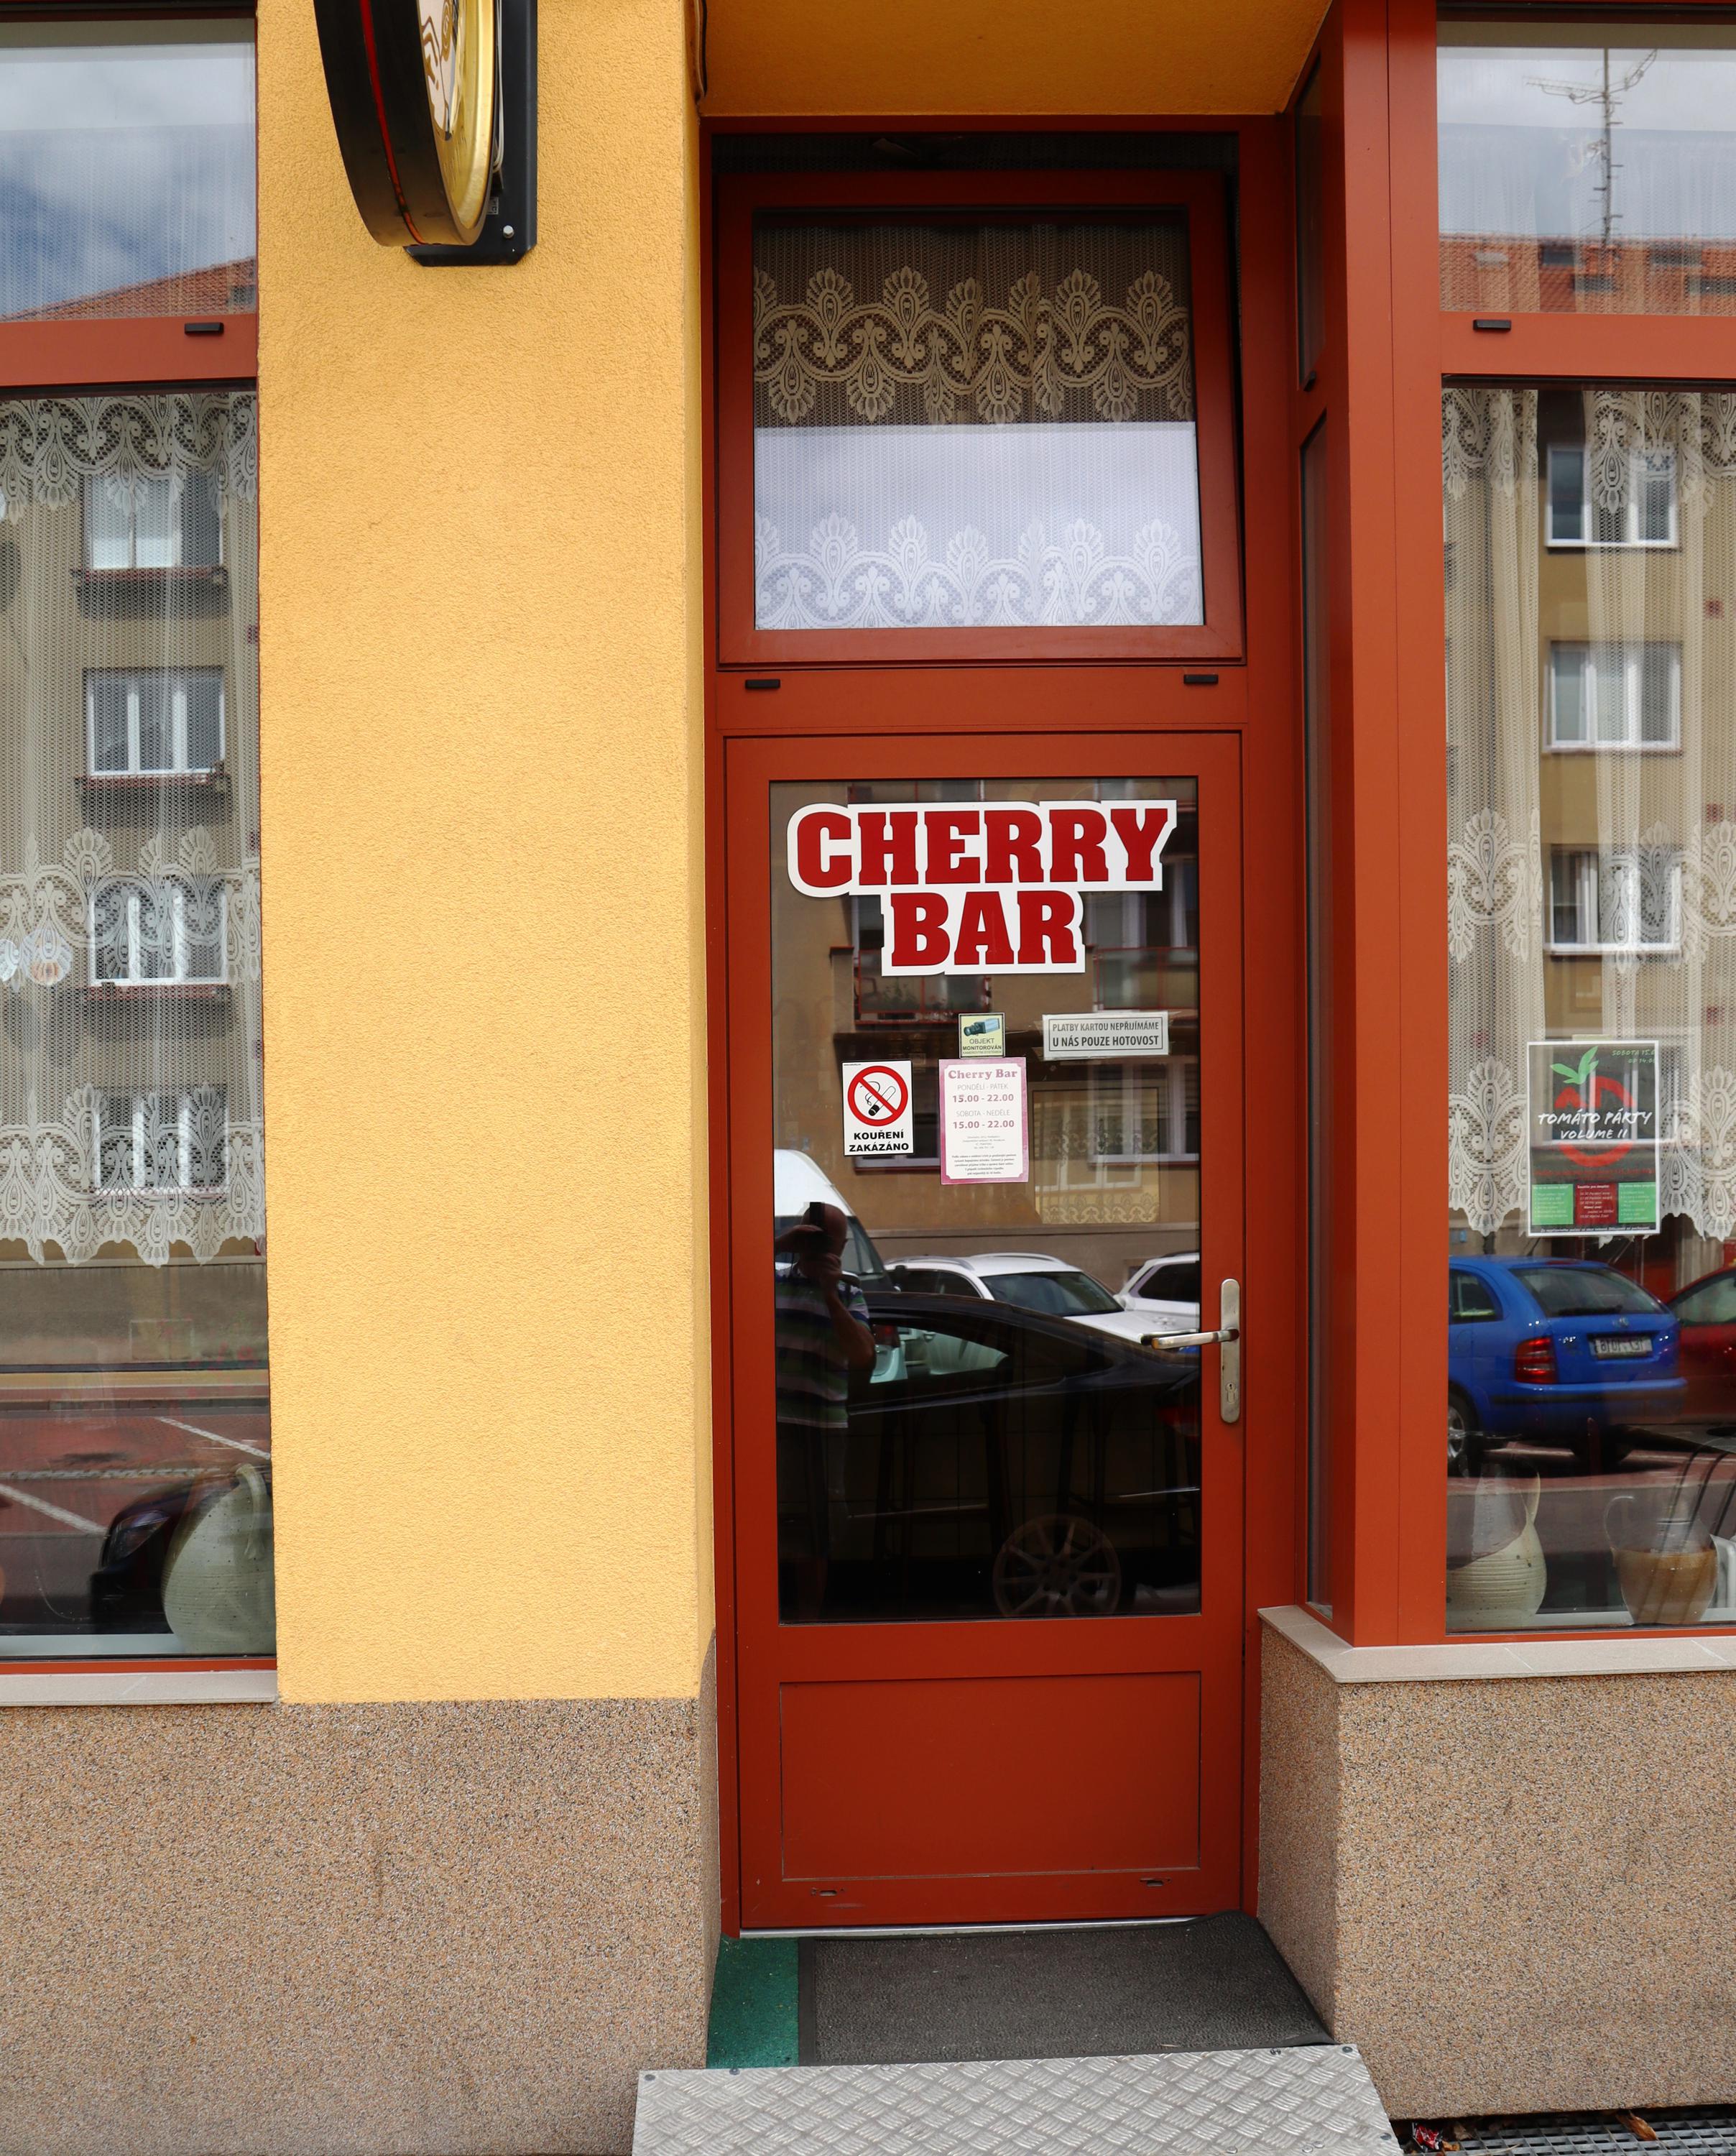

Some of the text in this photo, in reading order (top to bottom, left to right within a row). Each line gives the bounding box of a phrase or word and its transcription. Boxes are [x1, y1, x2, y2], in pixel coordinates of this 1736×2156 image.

[797, 808, 1168, 888] CHERRY
[891, 890, 1077, 967] BAR
[1053, 1021, 1159, 1032] PLATBY KARTOU NEPŘIJÍMÁME
[1053, 1035, 1159, 1046] U NÁS POUZE HOTOVOST
[948, 1069, 1017, 1080] Cherry Bar
[1538, 1107, 1653, 1125] TOMÁTO PÁRTY
[854, 1128, 904, 1140] KOUŘENÍ
[1561, 1130, 1614, 1140] VOLUME
[849, 1141, 909, 1152] ZAKÁZÁNO
